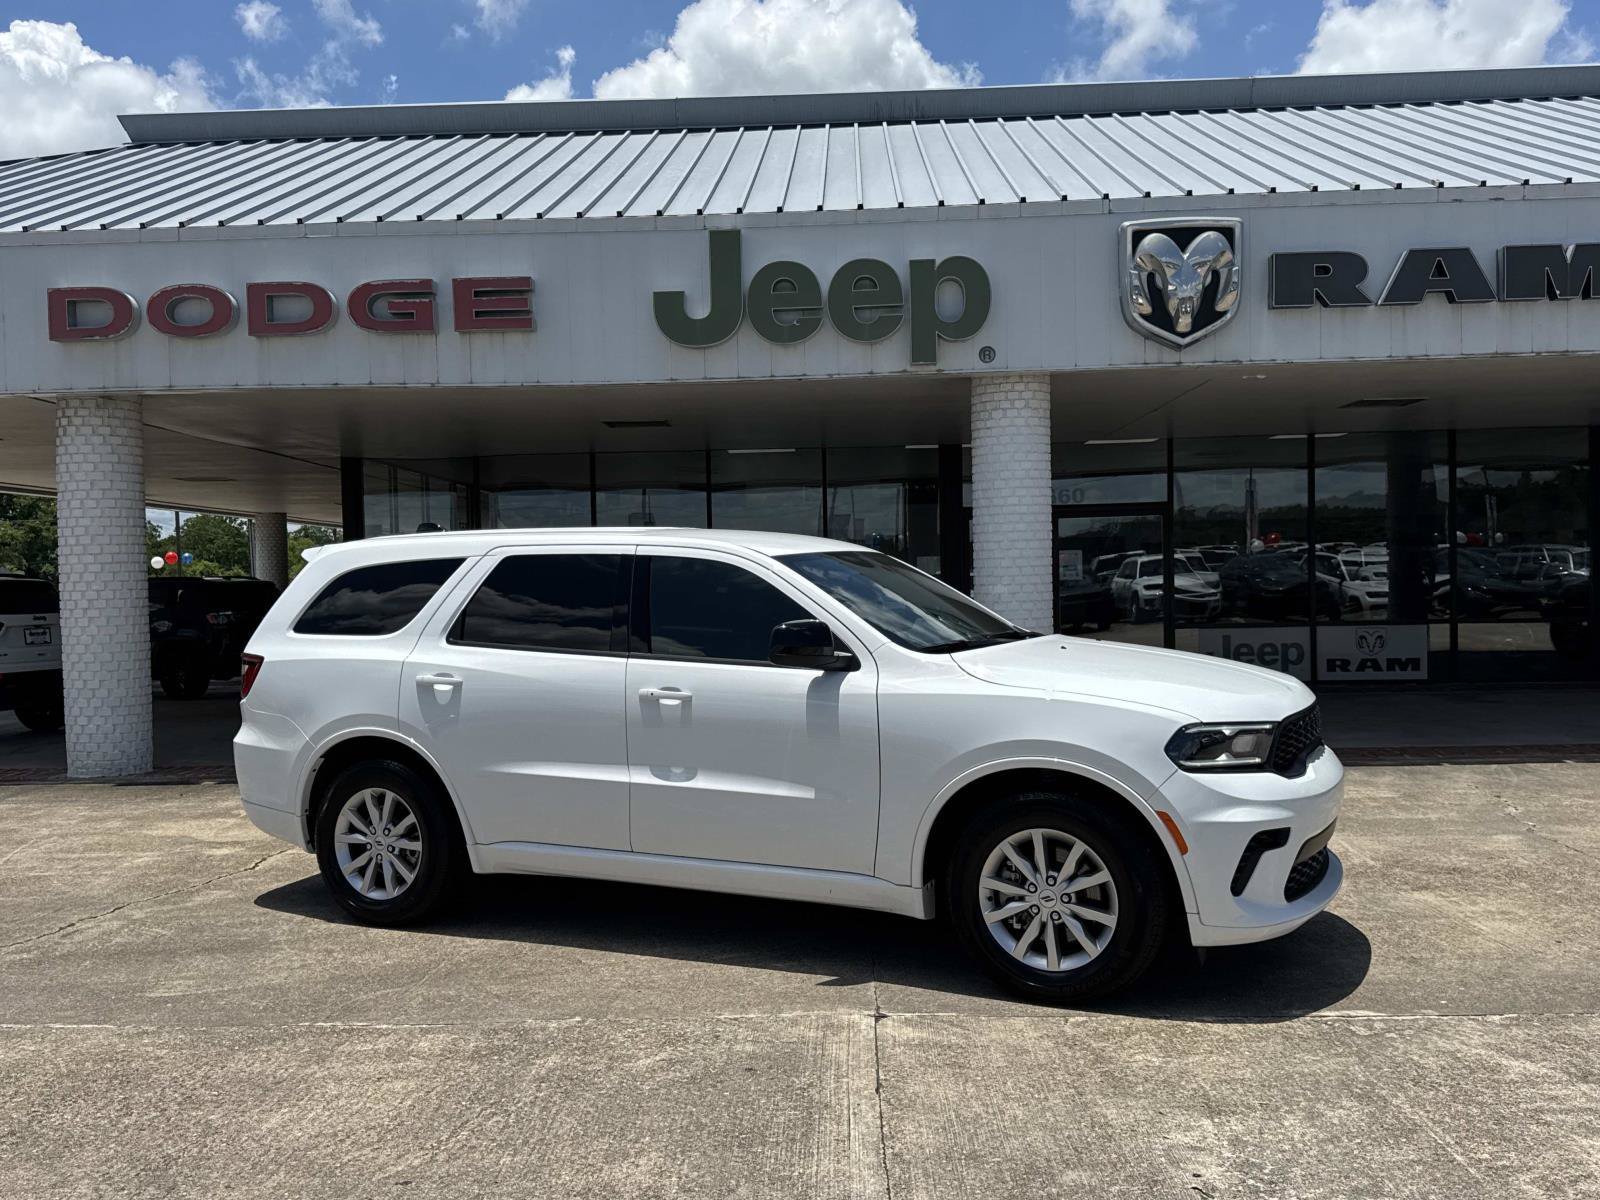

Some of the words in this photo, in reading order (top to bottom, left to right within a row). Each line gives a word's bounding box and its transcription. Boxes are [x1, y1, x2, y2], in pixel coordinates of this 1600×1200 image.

[47, 276, 536, 342] DODGE
[652, 228, 992, 366] Jeep
[1267, 241, 1600, 310] RAM
[1326, 657, 1421, 673] RAM
